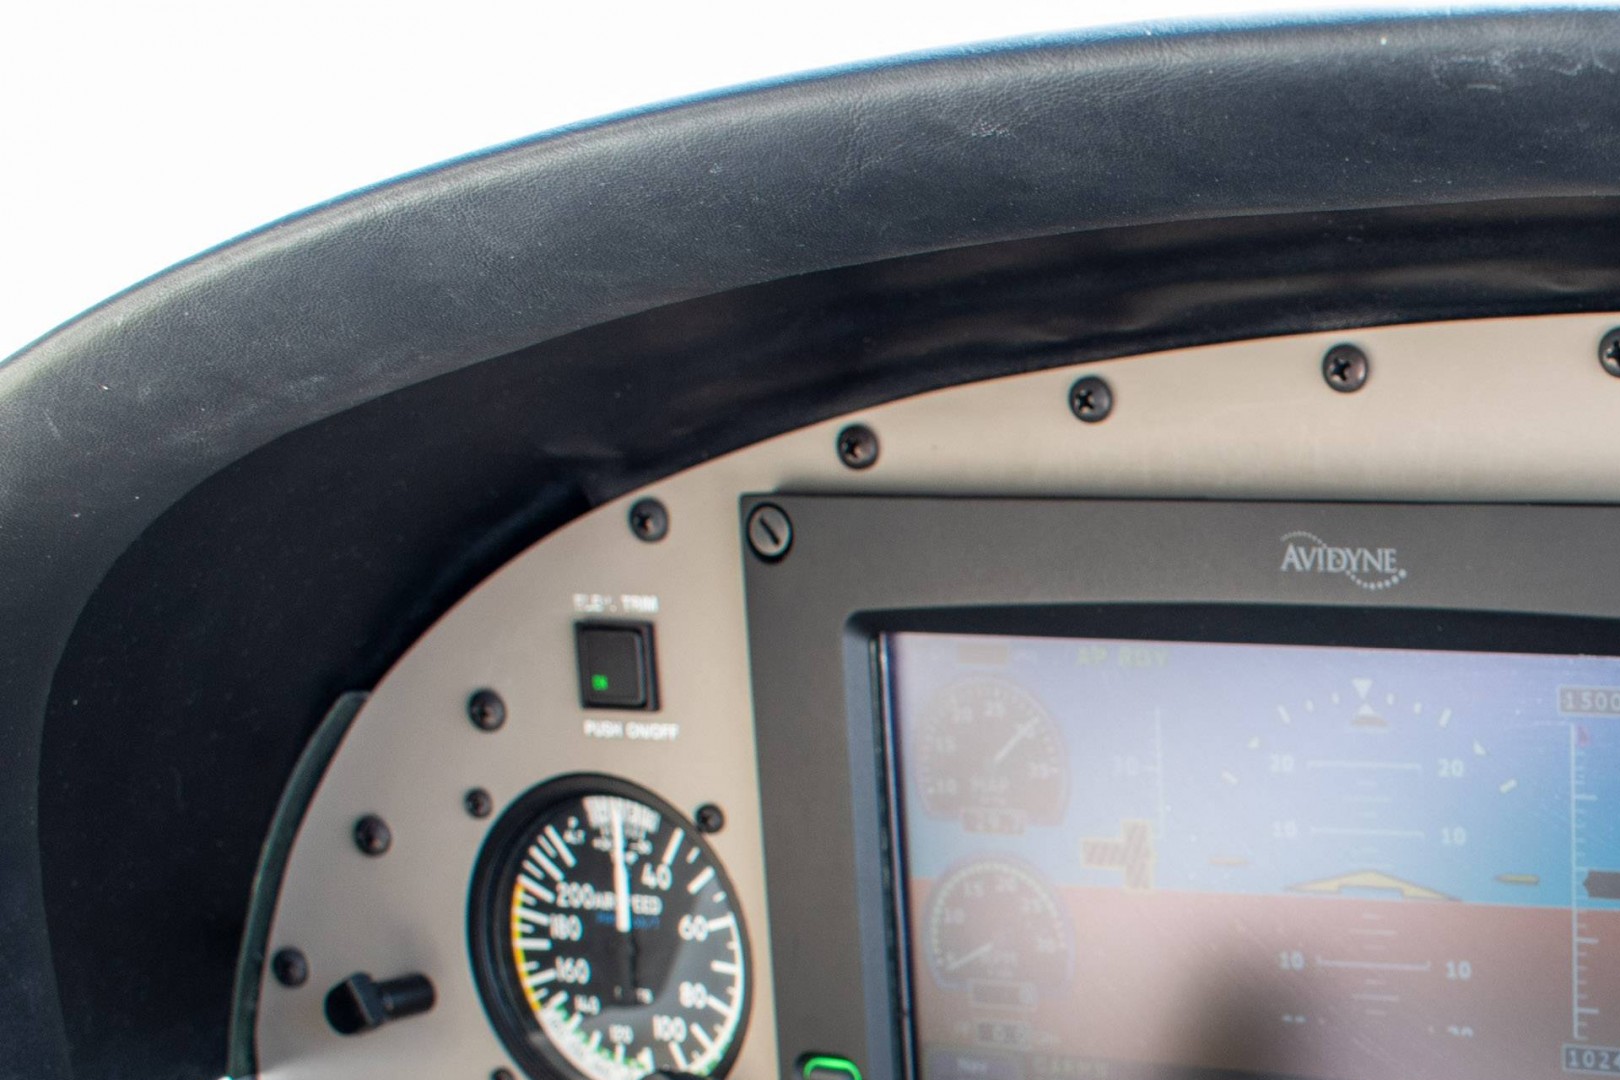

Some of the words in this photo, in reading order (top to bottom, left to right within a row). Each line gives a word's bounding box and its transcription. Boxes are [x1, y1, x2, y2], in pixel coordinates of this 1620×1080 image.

[1280, 543, 1398, 573] AVIDYNE
[1441, 827, 1466, 845] 10
[640, 860, 673, 890] 40
